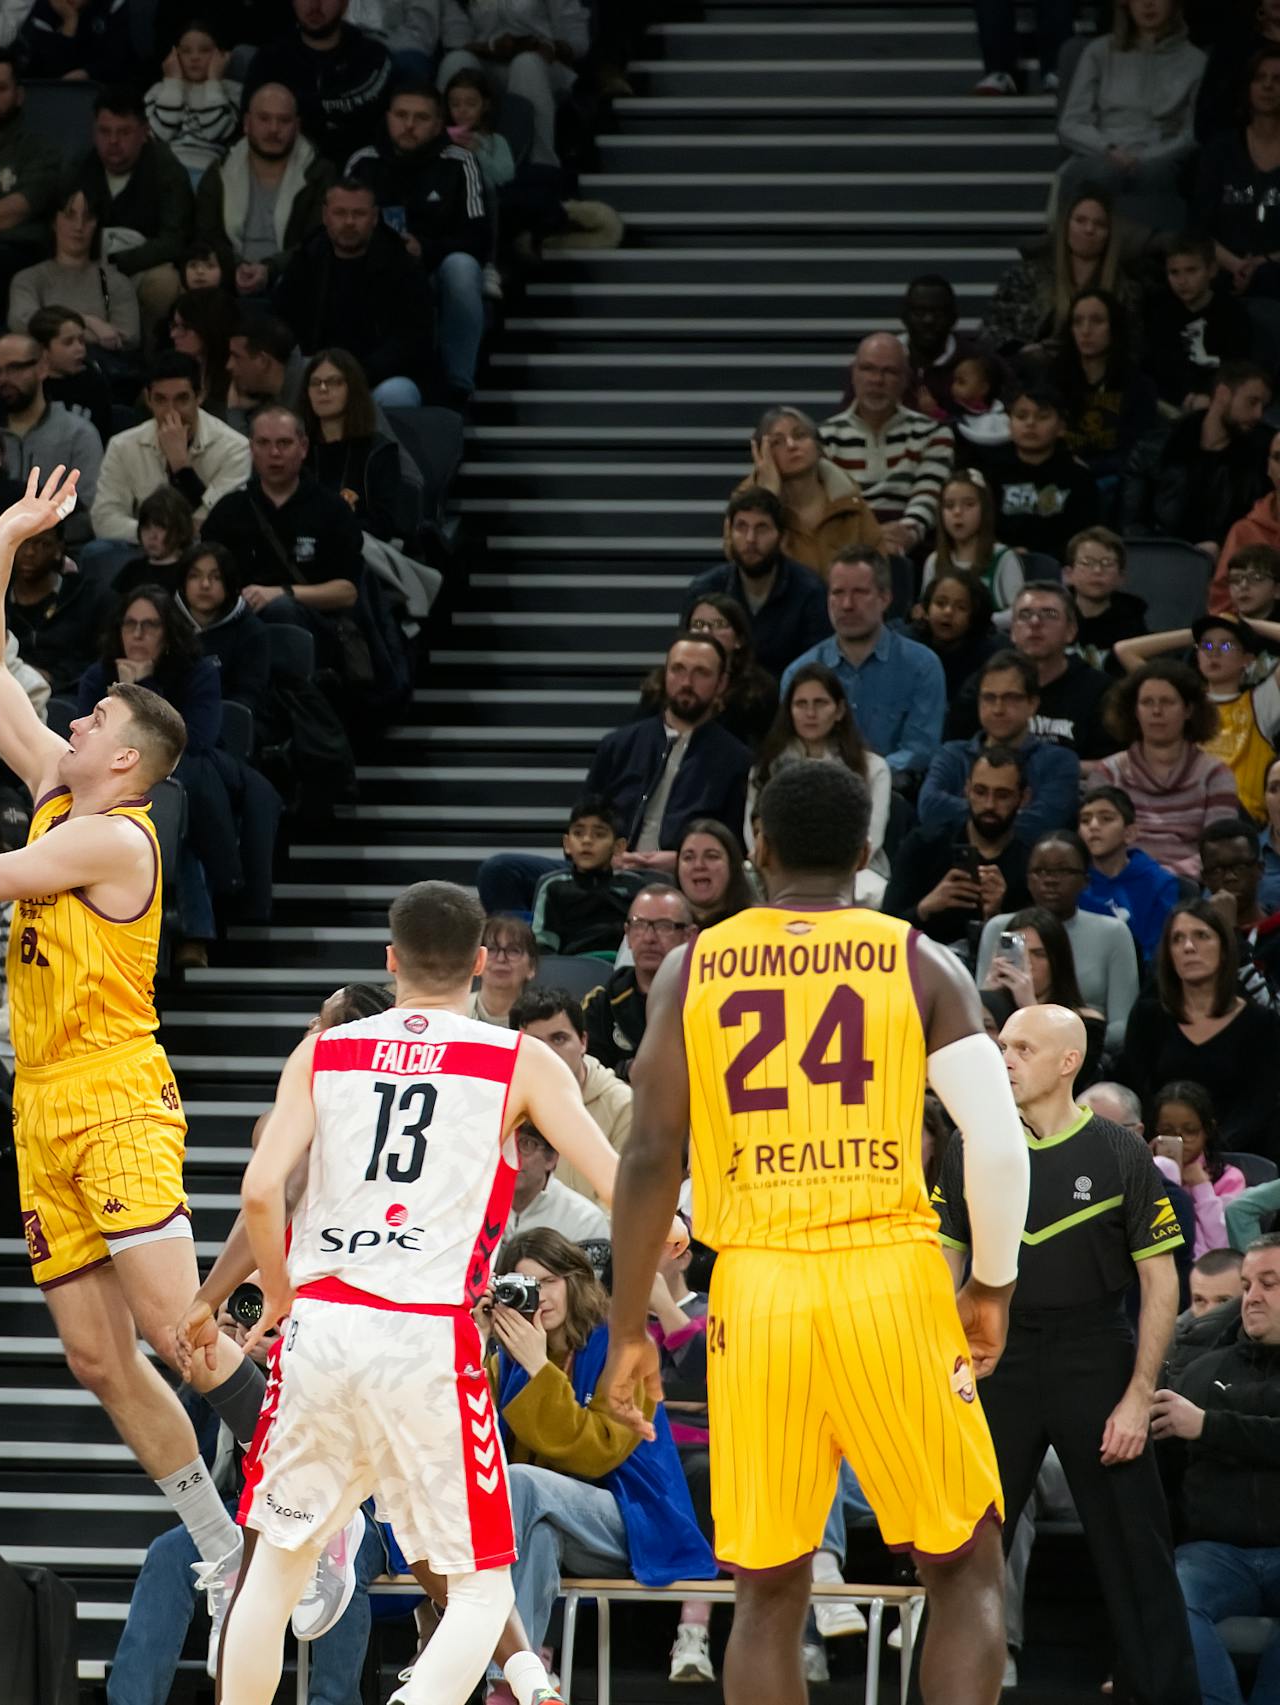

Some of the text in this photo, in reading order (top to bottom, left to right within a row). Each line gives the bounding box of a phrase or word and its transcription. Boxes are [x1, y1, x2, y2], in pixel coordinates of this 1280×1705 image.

[699, 940, 897, 984] HOUMOUNOU
[371, 1041, 448, 1075] FALCOZ
[718, 983, 875, 1115] 24
[161, 1082, 179, 1111] 88
[365, 1081, 438, 1184] 13
[756, 1138, 900, 1175] REALITES
[320, 1227, 425, 1254] SPIE
[1152, 1228, 1167, 1240] LA
[709, 1315, 725, 1356] 24
[176, 1472, 203, 1493] 23
